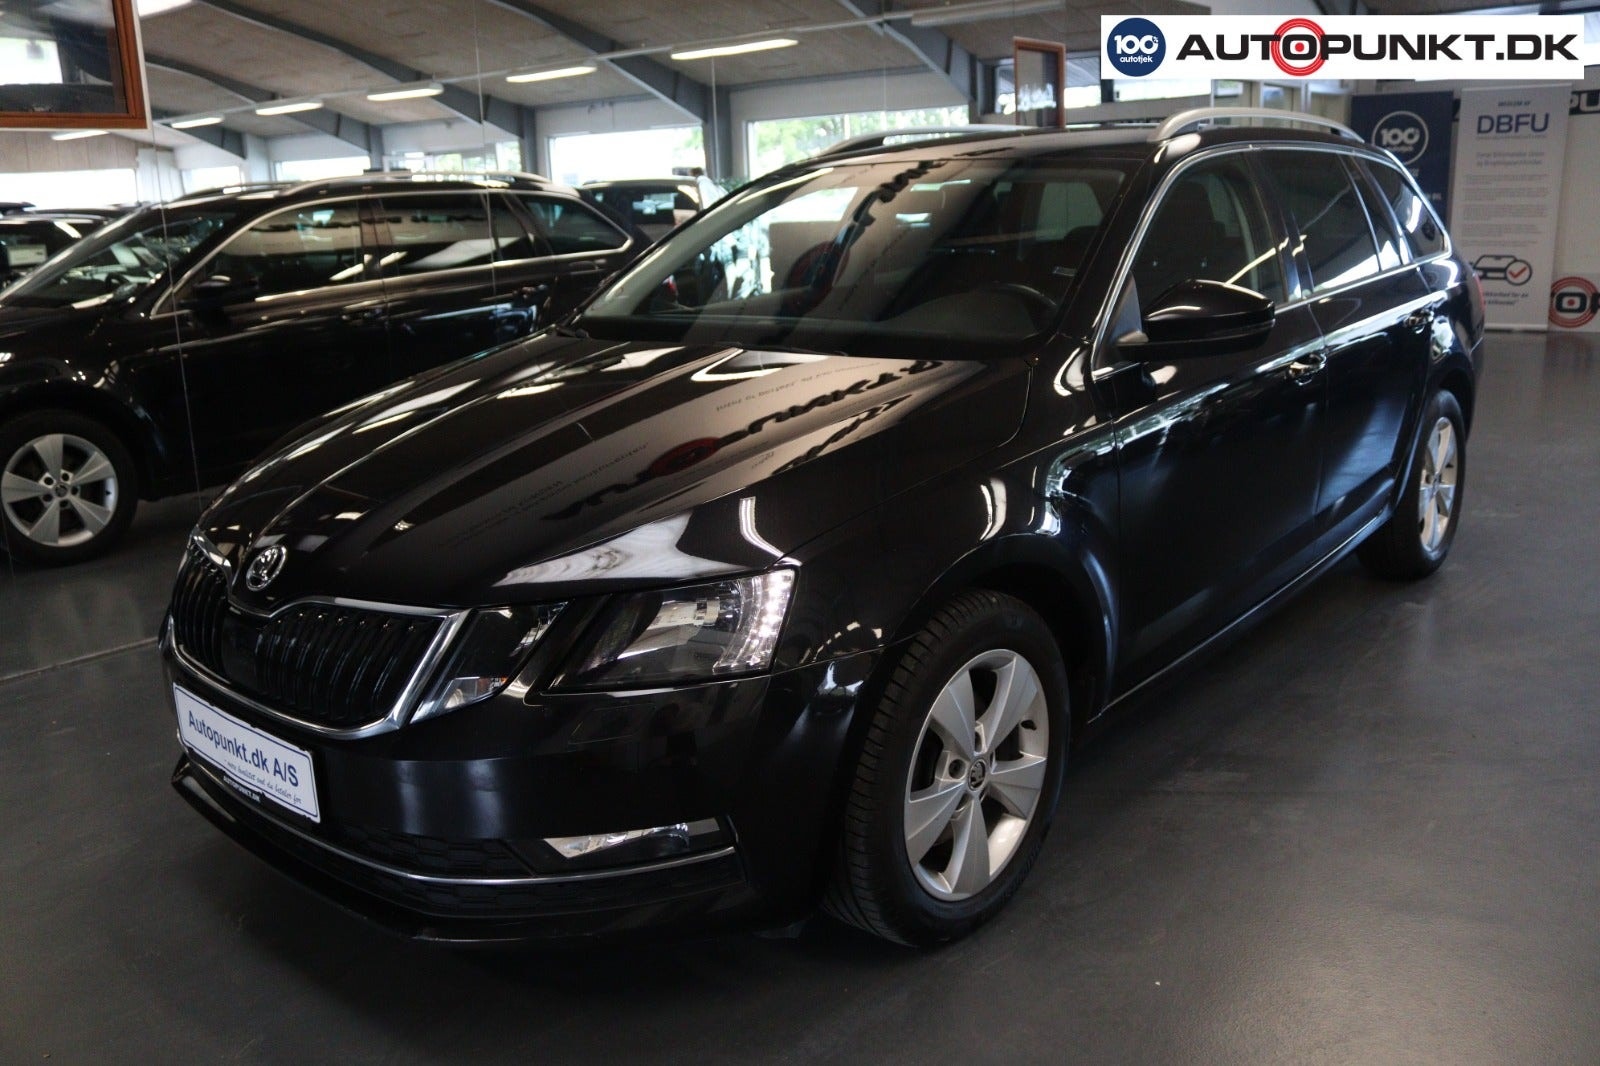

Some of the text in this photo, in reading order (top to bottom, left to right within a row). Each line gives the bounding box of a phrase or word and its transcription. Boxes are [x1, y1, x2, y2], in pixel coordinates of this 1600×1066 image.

[1476, 112, 1550, 134] DBFU
[188, 709, 299, 788] Autopunkt.dk A/S
